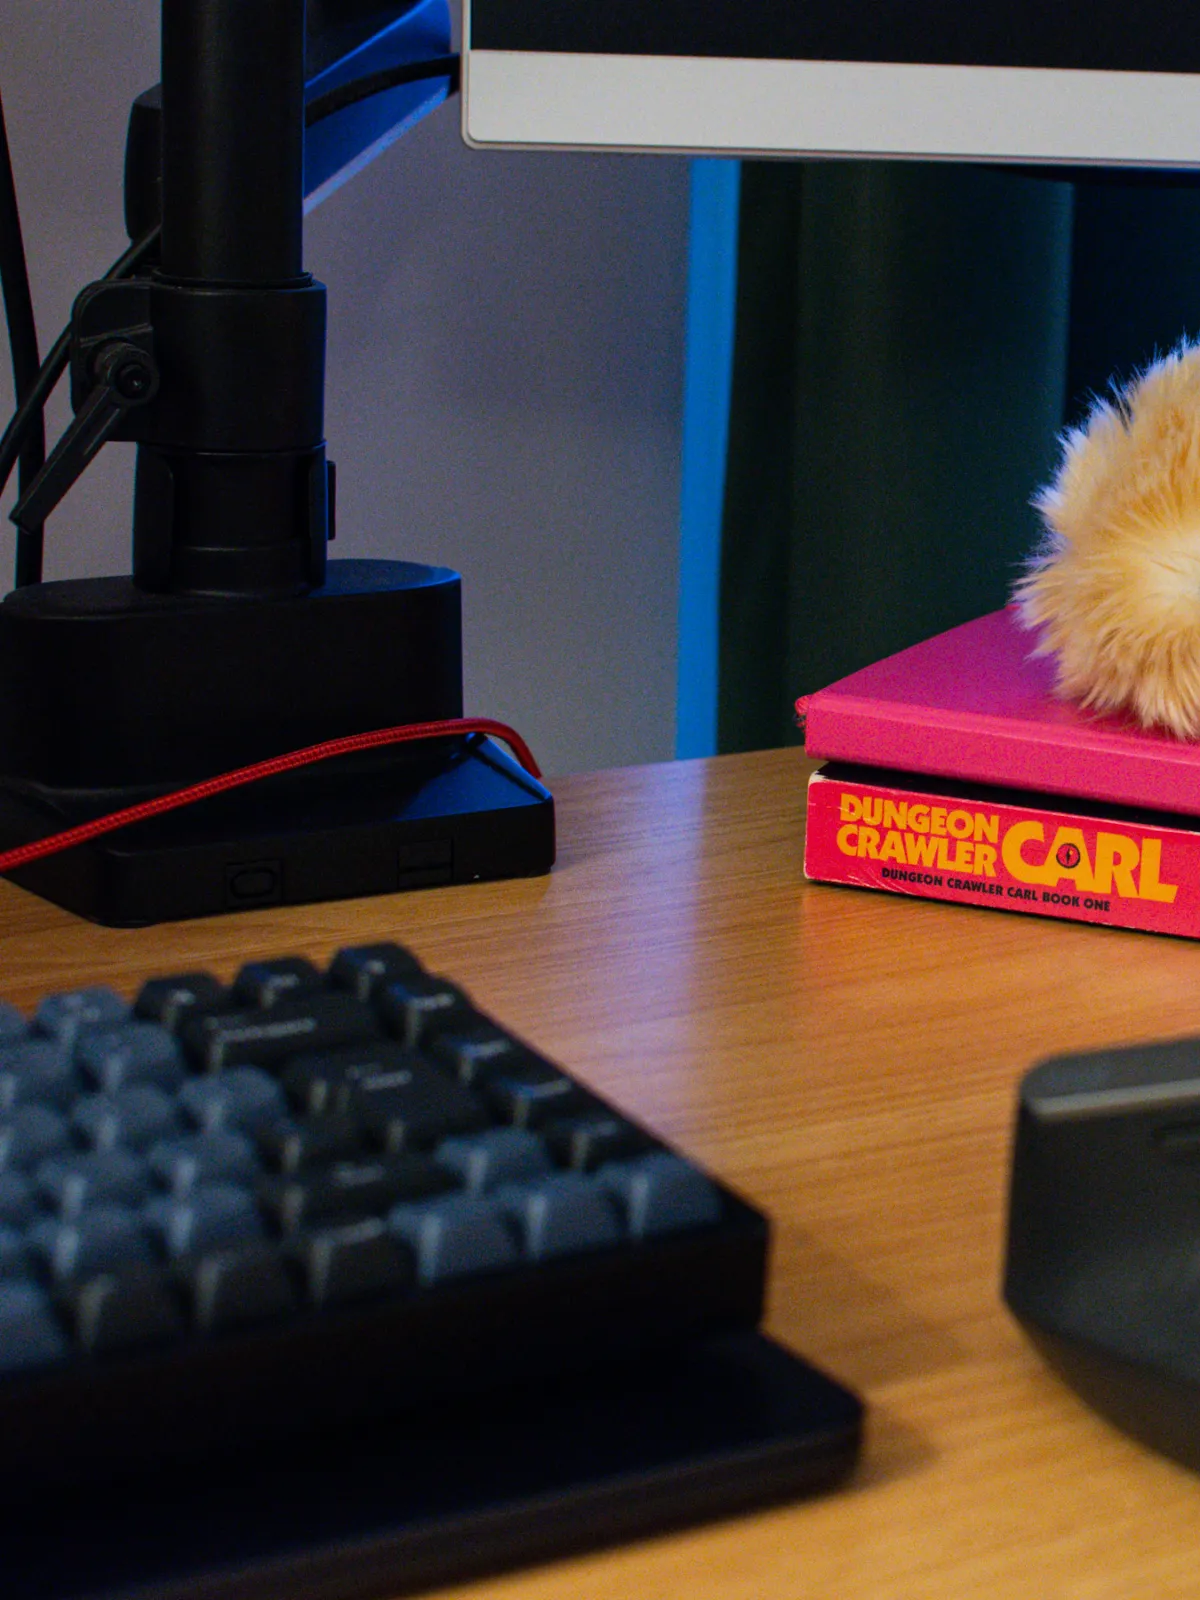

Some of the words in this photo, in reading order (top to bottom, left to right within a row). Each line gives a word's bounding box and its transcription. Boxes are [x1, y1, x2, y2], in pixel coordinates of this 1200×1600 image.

[839, 793, 1000, 843] DUNGEON
[836, 825, 998, 877] CRAWLER
[1001, 820, 1179, 903] CARL
[881, 867, 943, 886] DUNGEON
[947, 877, 1003, 896] CRAWLER
[1007, 886, 1038, 901] CARL
[1042, 892, 1080, 907] BOOK
[1083, 898, 1111, 911] ONE
